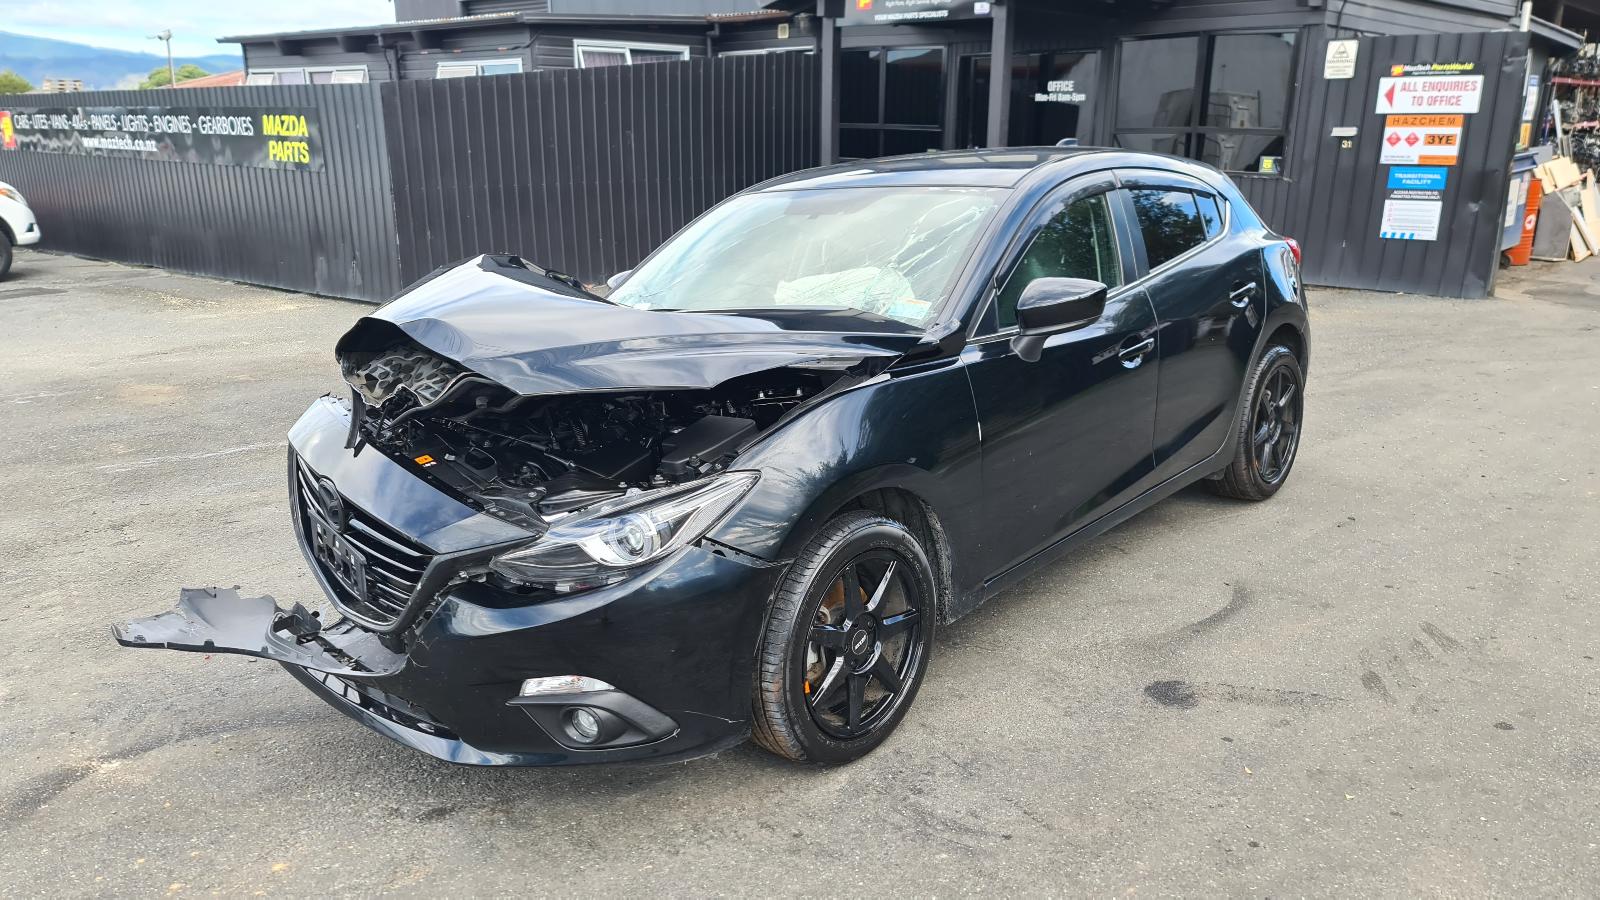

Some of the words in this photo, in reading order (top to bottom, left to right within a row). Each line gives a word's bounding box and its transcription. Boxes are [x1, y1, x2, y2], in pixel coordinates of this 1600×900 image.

[1047, 80, 1075, 92] OFFICE
[1400, 81, 1418, 92] ALL
[1421, 80, 1478, 92] ENQUIRIES
[1411, 95, 1424, 106] TO
[1426, 95, 1463, 106] OFFICE
[90, 114, 117, 131] PANELS
[121, 115, 148, 132] LIGHTS
[152, 115, 192, 134] ENGINES
[198, 115, 254, 136] GEARBOXES
[262, 114, 309, 137] MAZDA
[1392, 116, 1456, 126] HAZCHEM
[1341, 140, 1352, 148] 31
[1428, 135, 1454, 145] 3YE
[268, 140, 310, 164] PARTS
